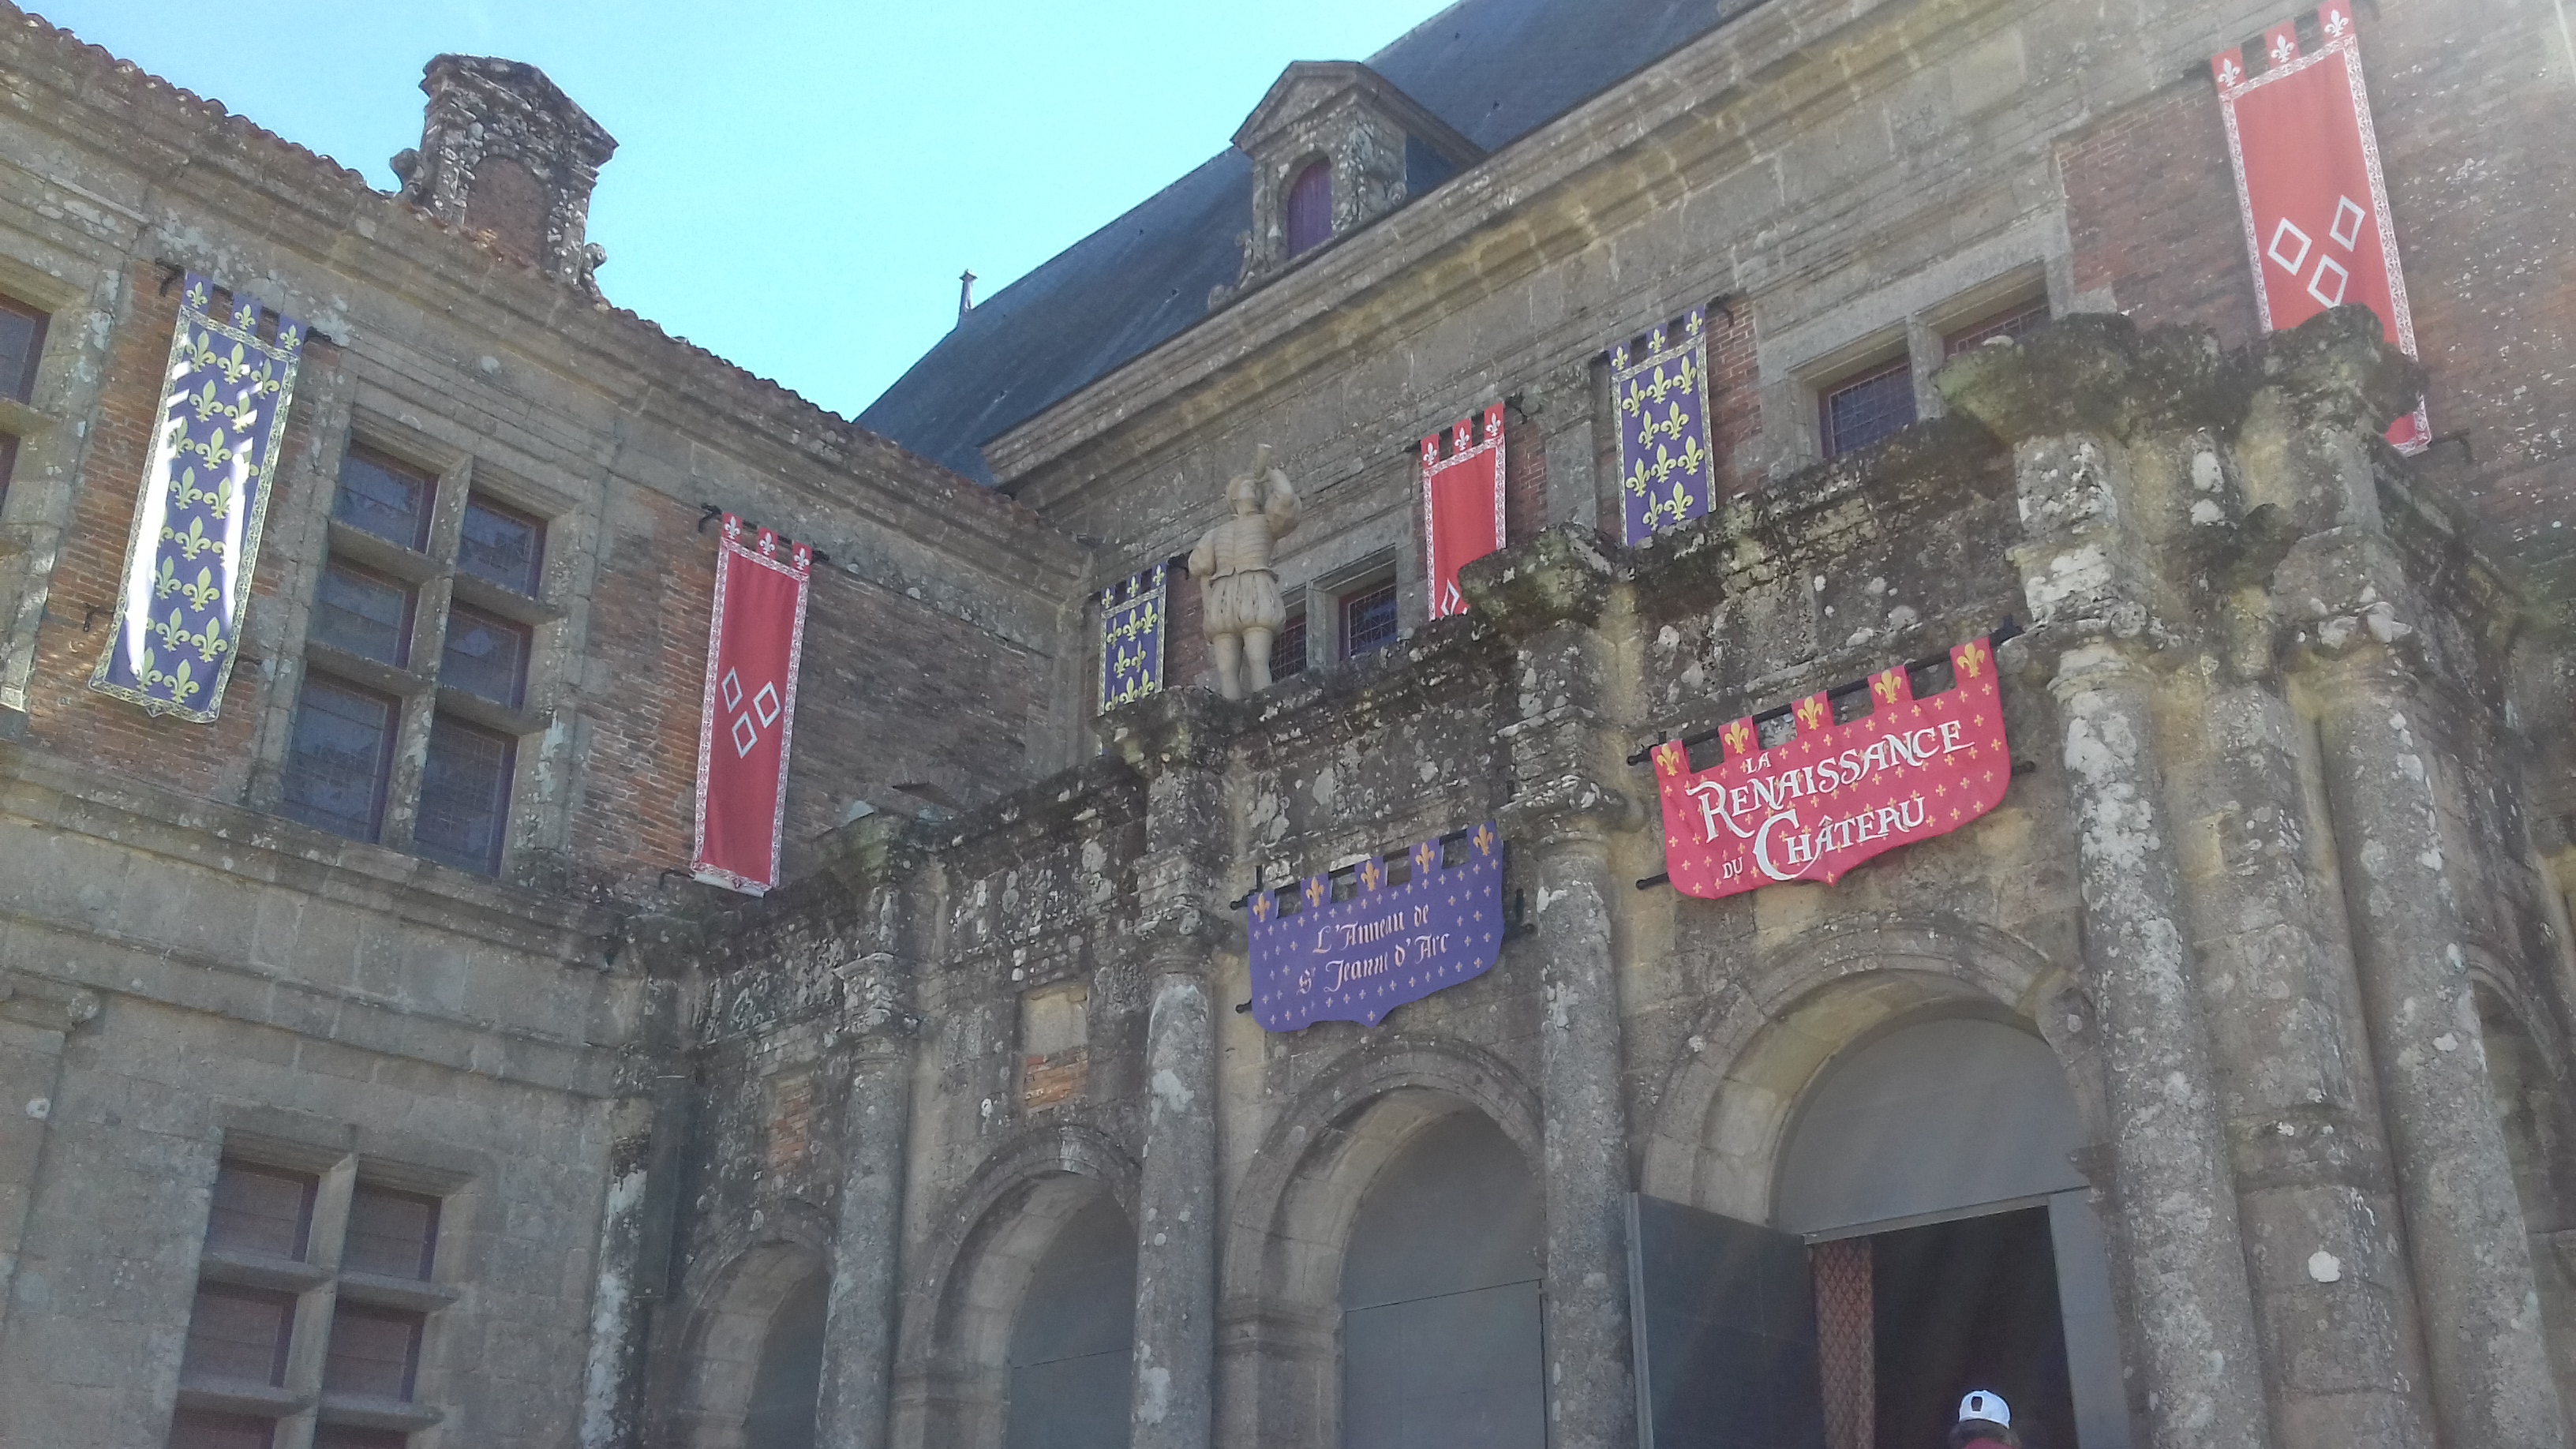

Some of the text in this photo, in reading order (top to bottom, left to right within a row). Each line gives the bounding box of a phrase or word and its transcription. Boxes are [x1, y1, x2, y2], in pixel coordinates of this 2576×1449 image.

[1687, 720, 1975, 844] RENAISSANCE
[1745, 752, 1772, 774] LA
[1722, 796, 1926, 882] DU CHÂTEAU
[1312, 904, 1429, 953] L'Anneau de
